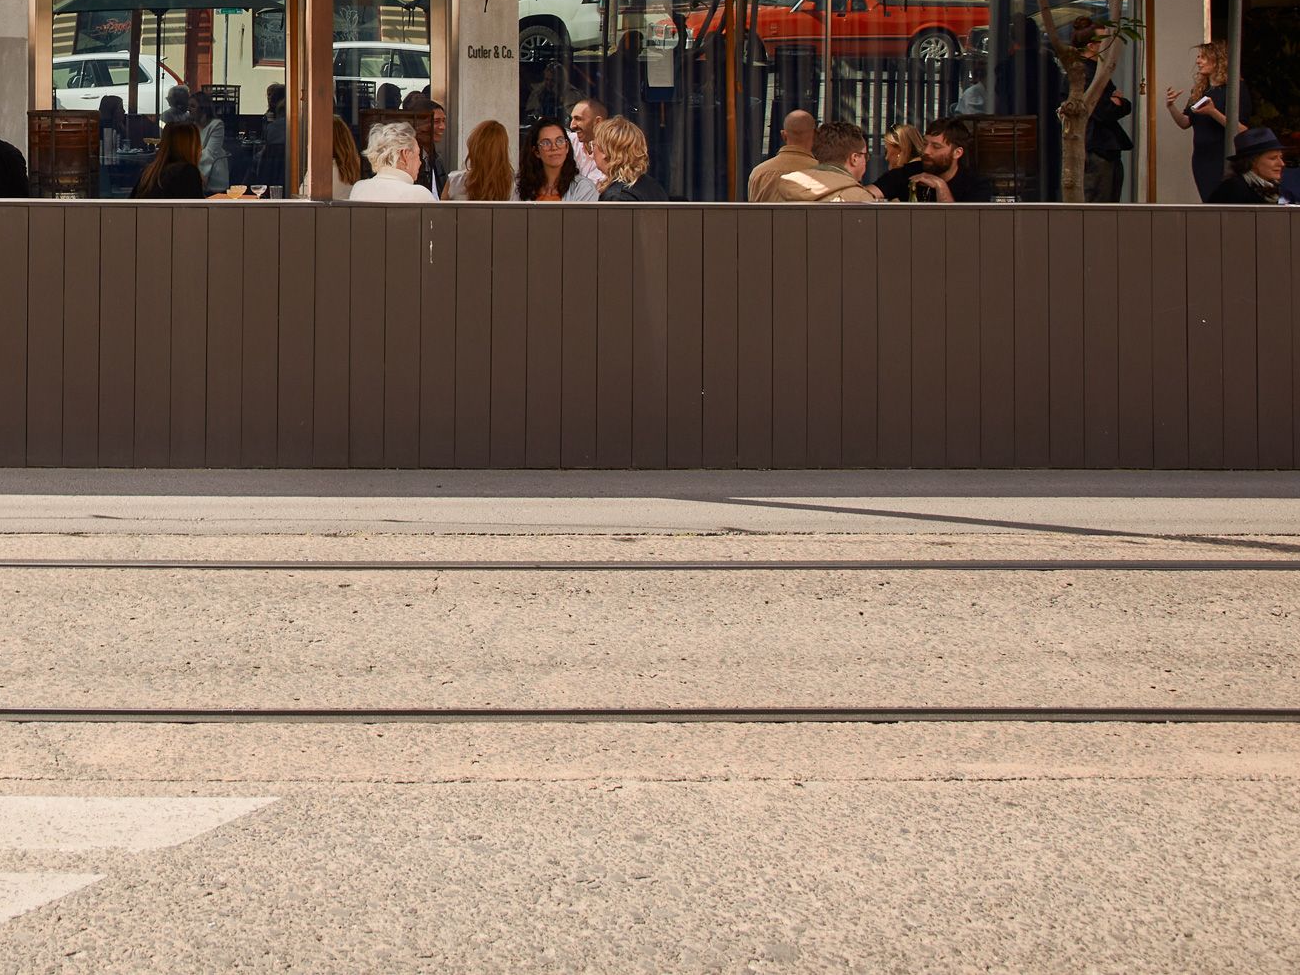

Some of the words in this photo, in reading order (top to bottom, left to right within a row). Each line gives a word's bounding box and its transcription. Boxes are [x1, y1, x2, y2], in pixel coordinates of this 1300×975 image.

[467, 45, 492, 59] Cutler
[493, 45, 500, 59] &
[501, 45, 514, 59] Co.
